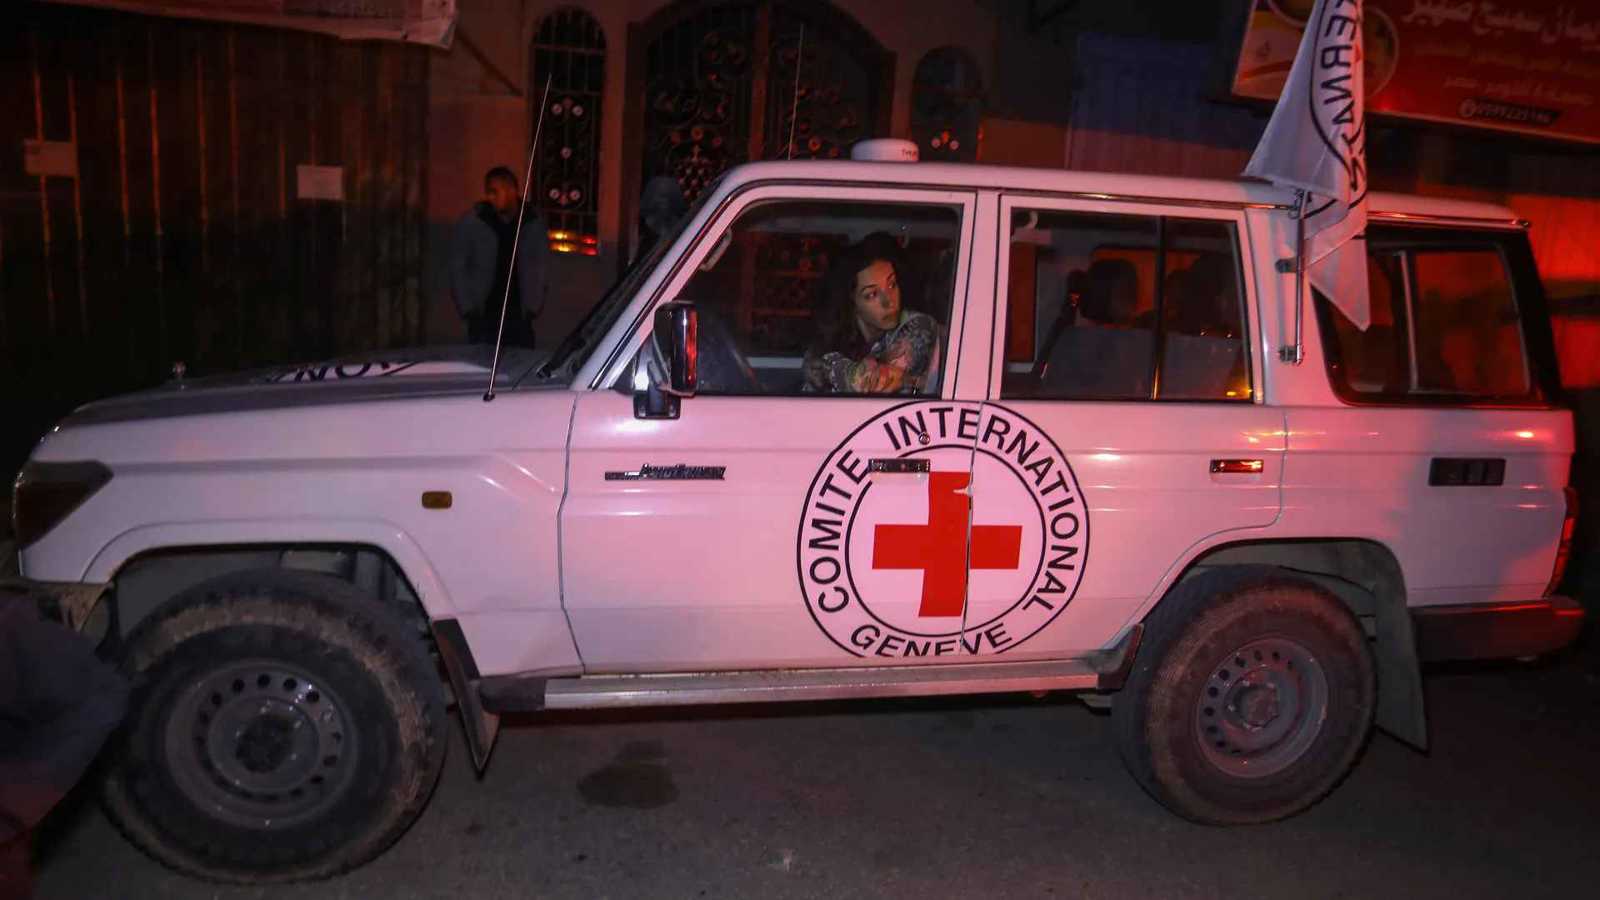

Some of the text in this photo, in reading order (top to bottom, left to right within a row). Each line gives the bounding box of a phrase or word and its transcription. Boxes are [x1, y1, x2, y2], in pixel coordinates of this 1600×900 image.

[808, 407, 1080, 613] COMITE INTERNATIONAL
[850, 621, 1013, 657] GENEVE
